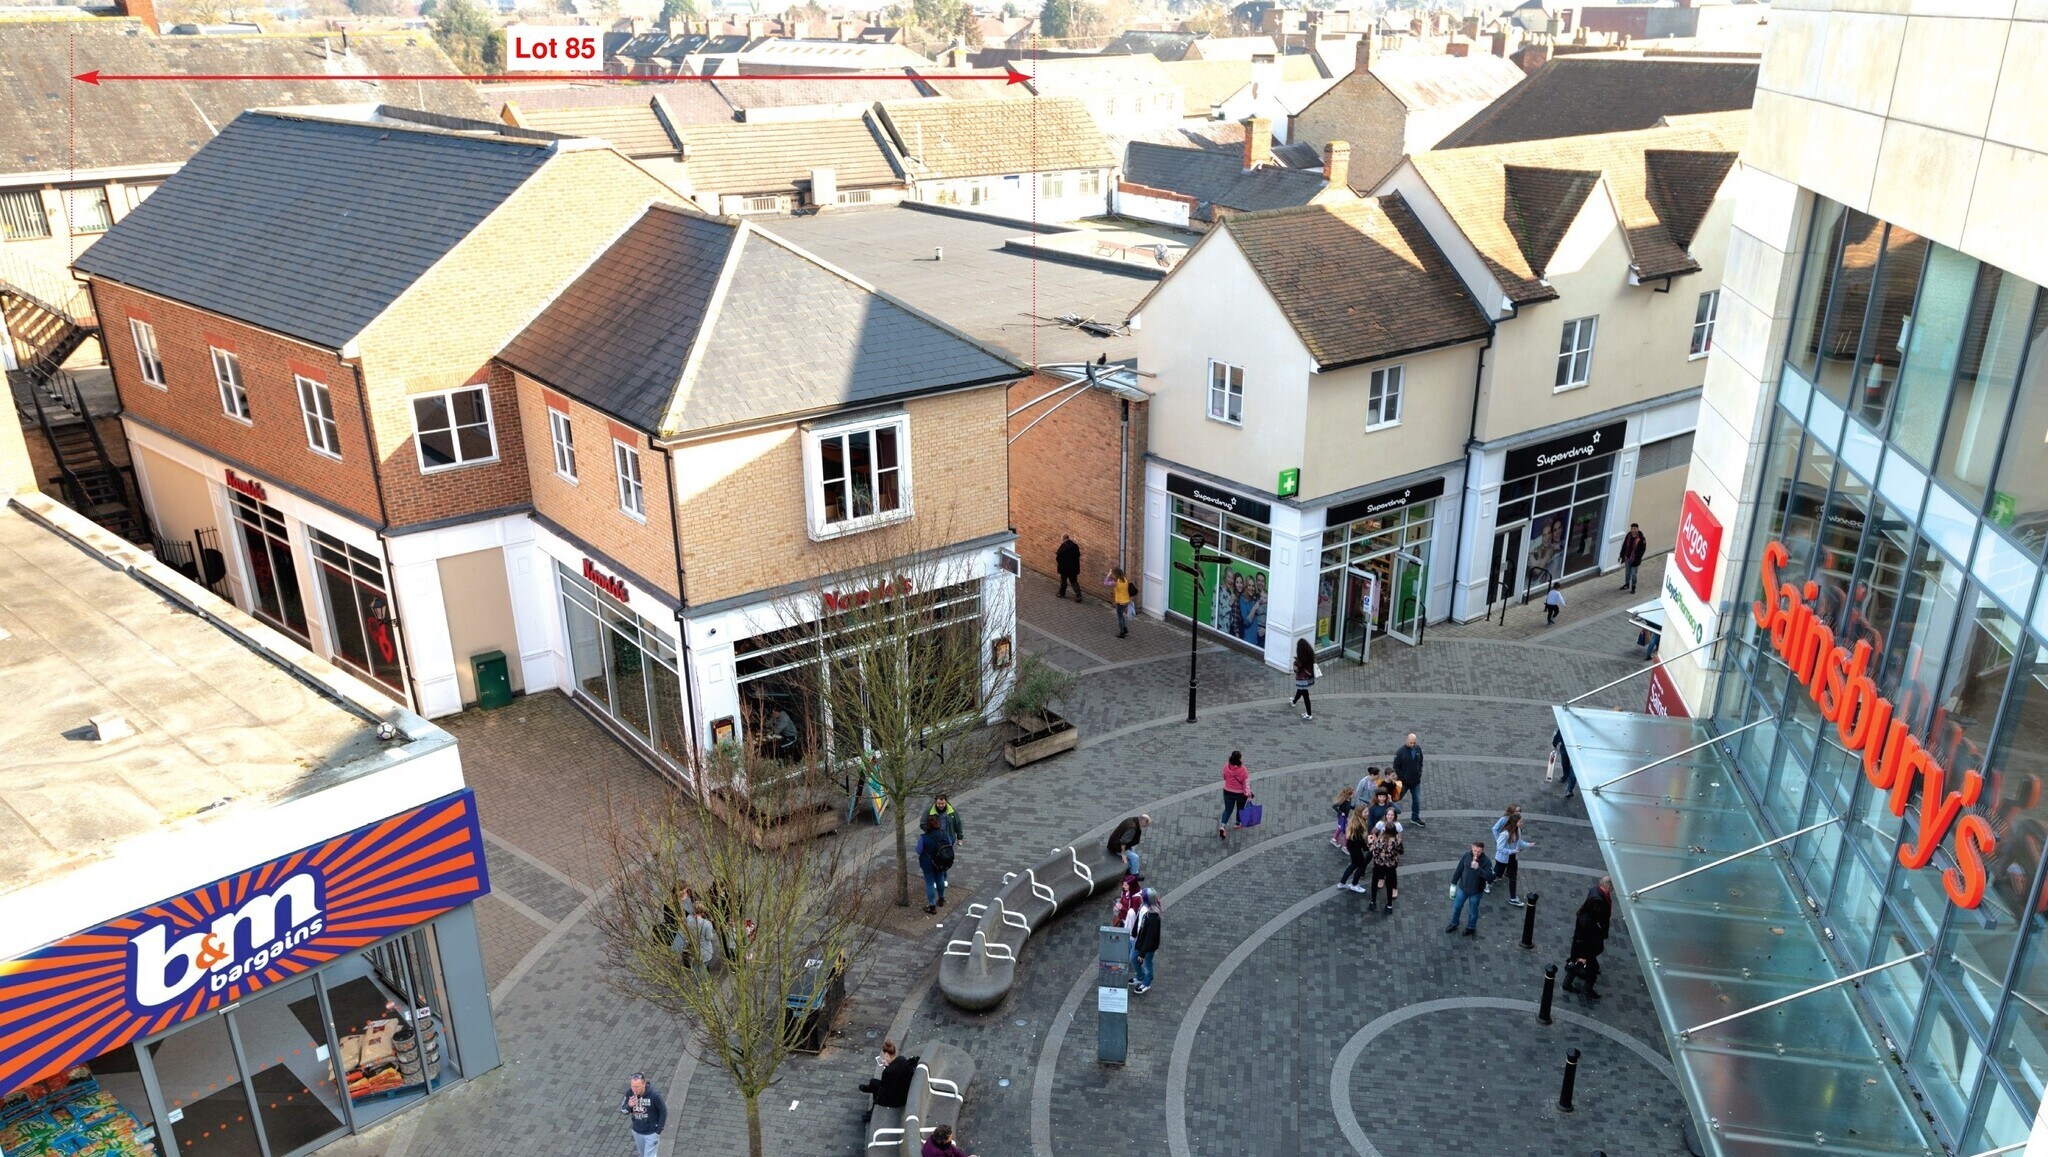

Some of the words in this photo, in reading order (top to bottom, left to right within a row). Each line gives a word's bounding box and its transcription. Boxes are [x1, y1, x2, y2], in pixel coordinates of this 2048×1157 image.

[1536, 445, 1595, 467] Superdrug
[1193, 489, 1233, 511] Superdrug
[1367, 498, 1406, 513] Superdrug
[1682, 511, 1708, 561] Argos
[582, 558, 630, 603] Nando's
[1752, 540, 1997, 910] Sainsbury's
[128, 872, 324, 1007] b&m
[210, 917, 324, 993] bargains
